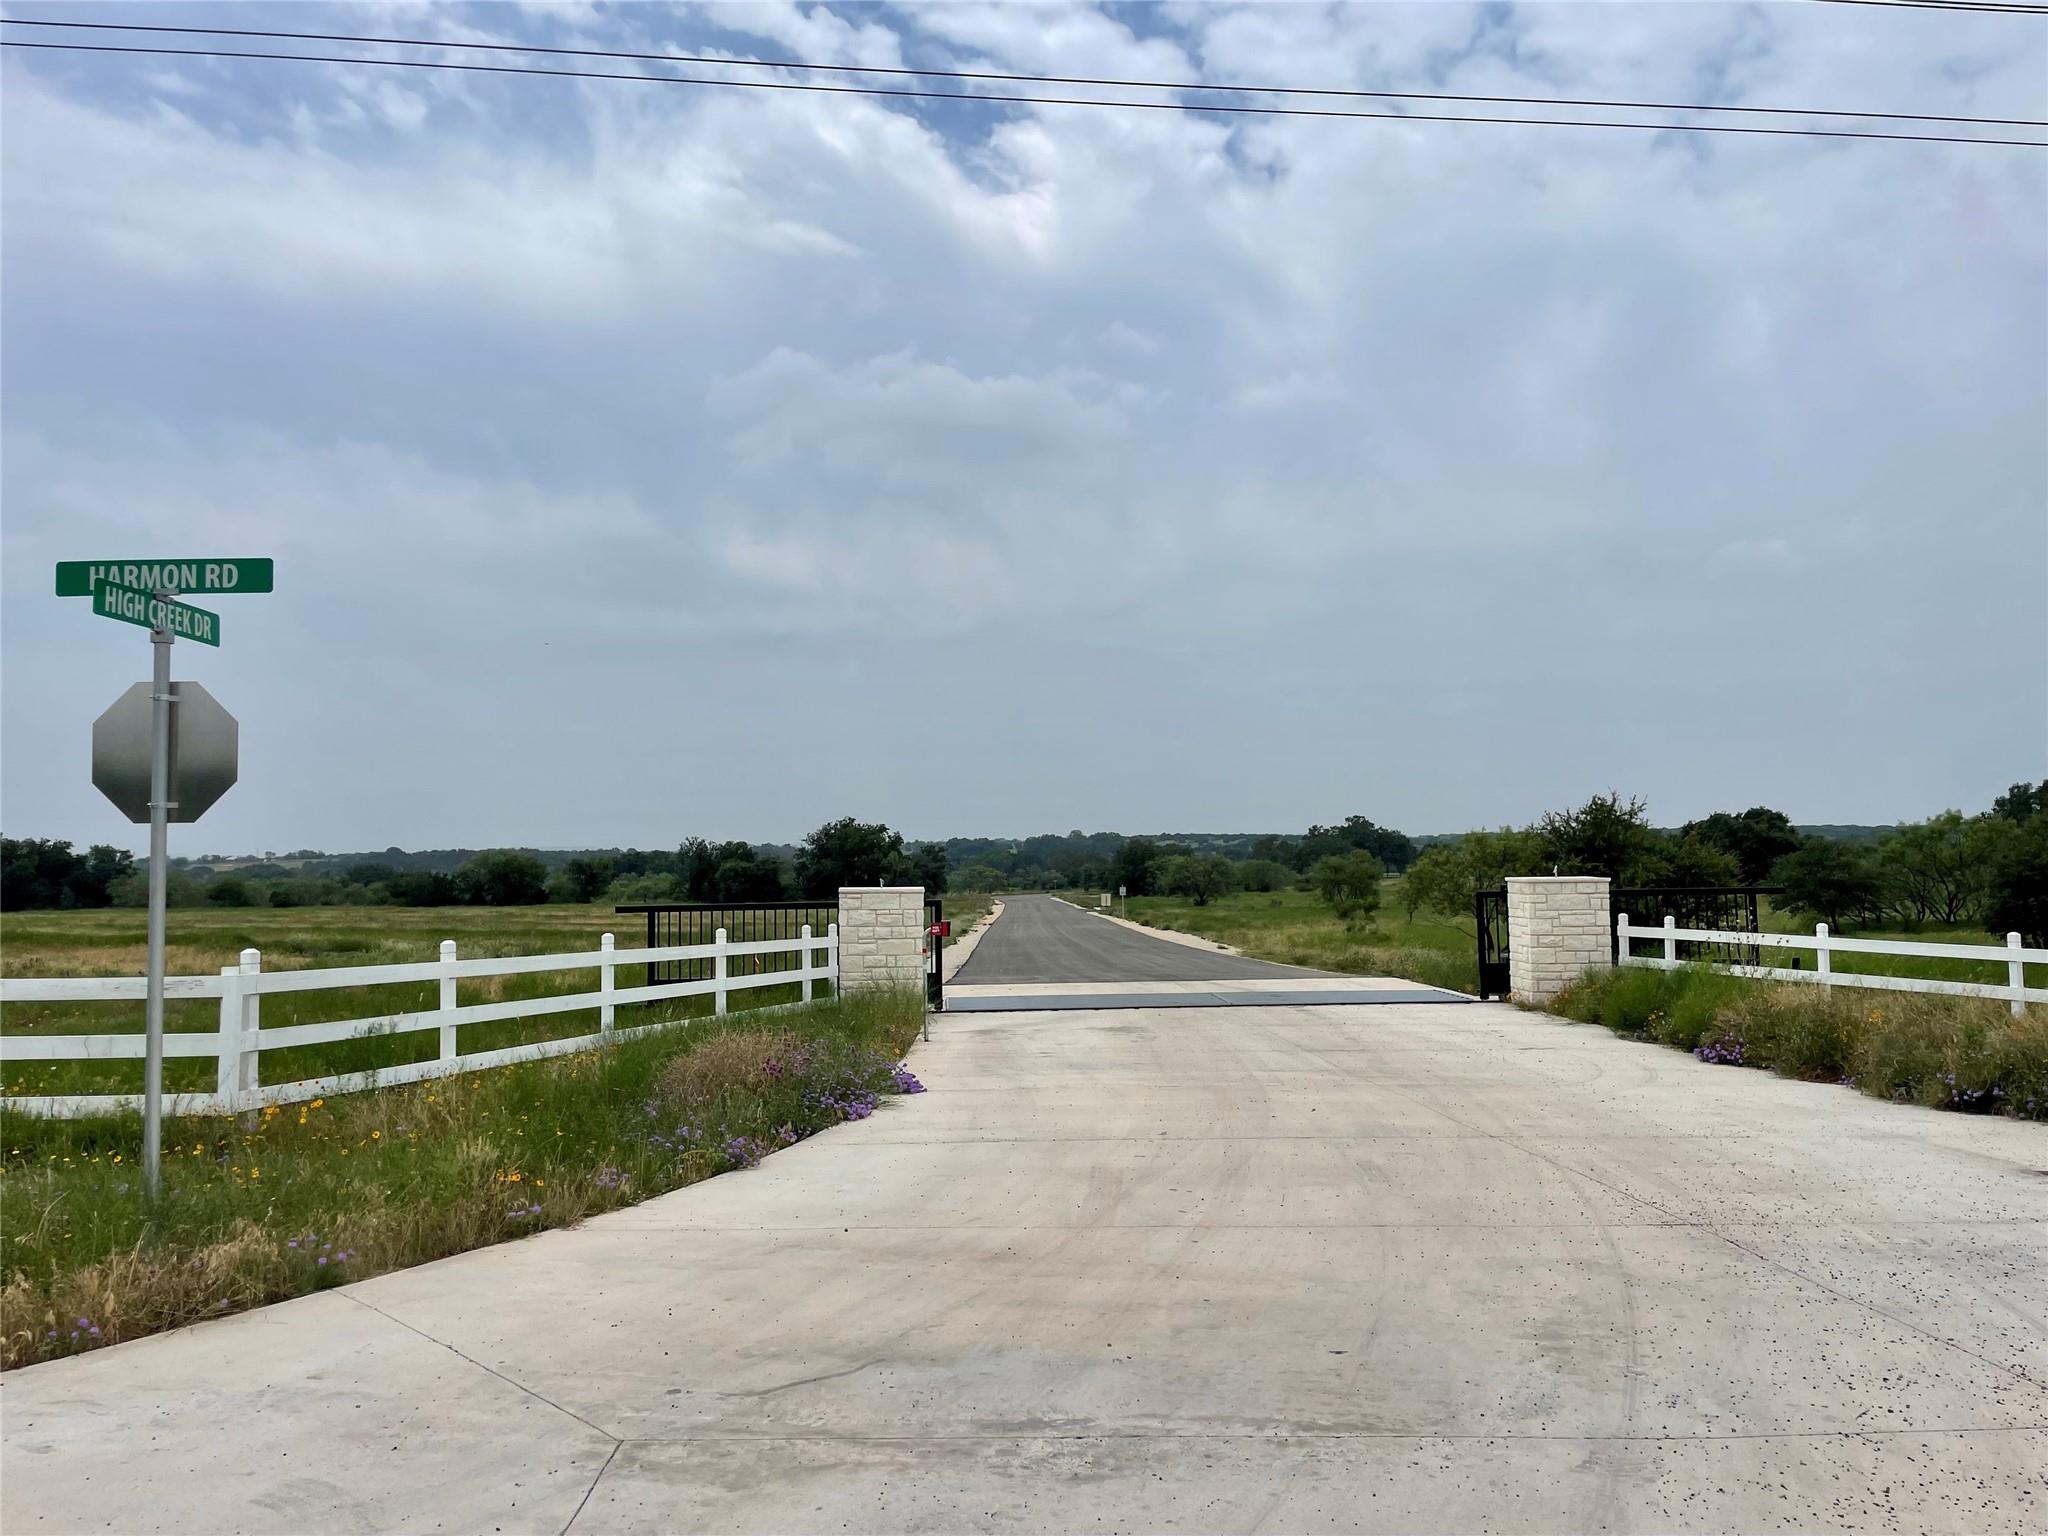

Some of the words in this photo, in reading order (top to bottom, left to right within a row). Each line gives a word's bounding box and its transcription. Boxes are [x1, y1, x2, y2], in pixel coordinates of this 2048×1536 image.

[89, 564, 197, 590] HARMON
[205, 563, 239, 588] RD
[104, 585, 145, 621] HIGH
[148, 600, 192, 634] CREEK
[194, 613, 212, 640] DR
